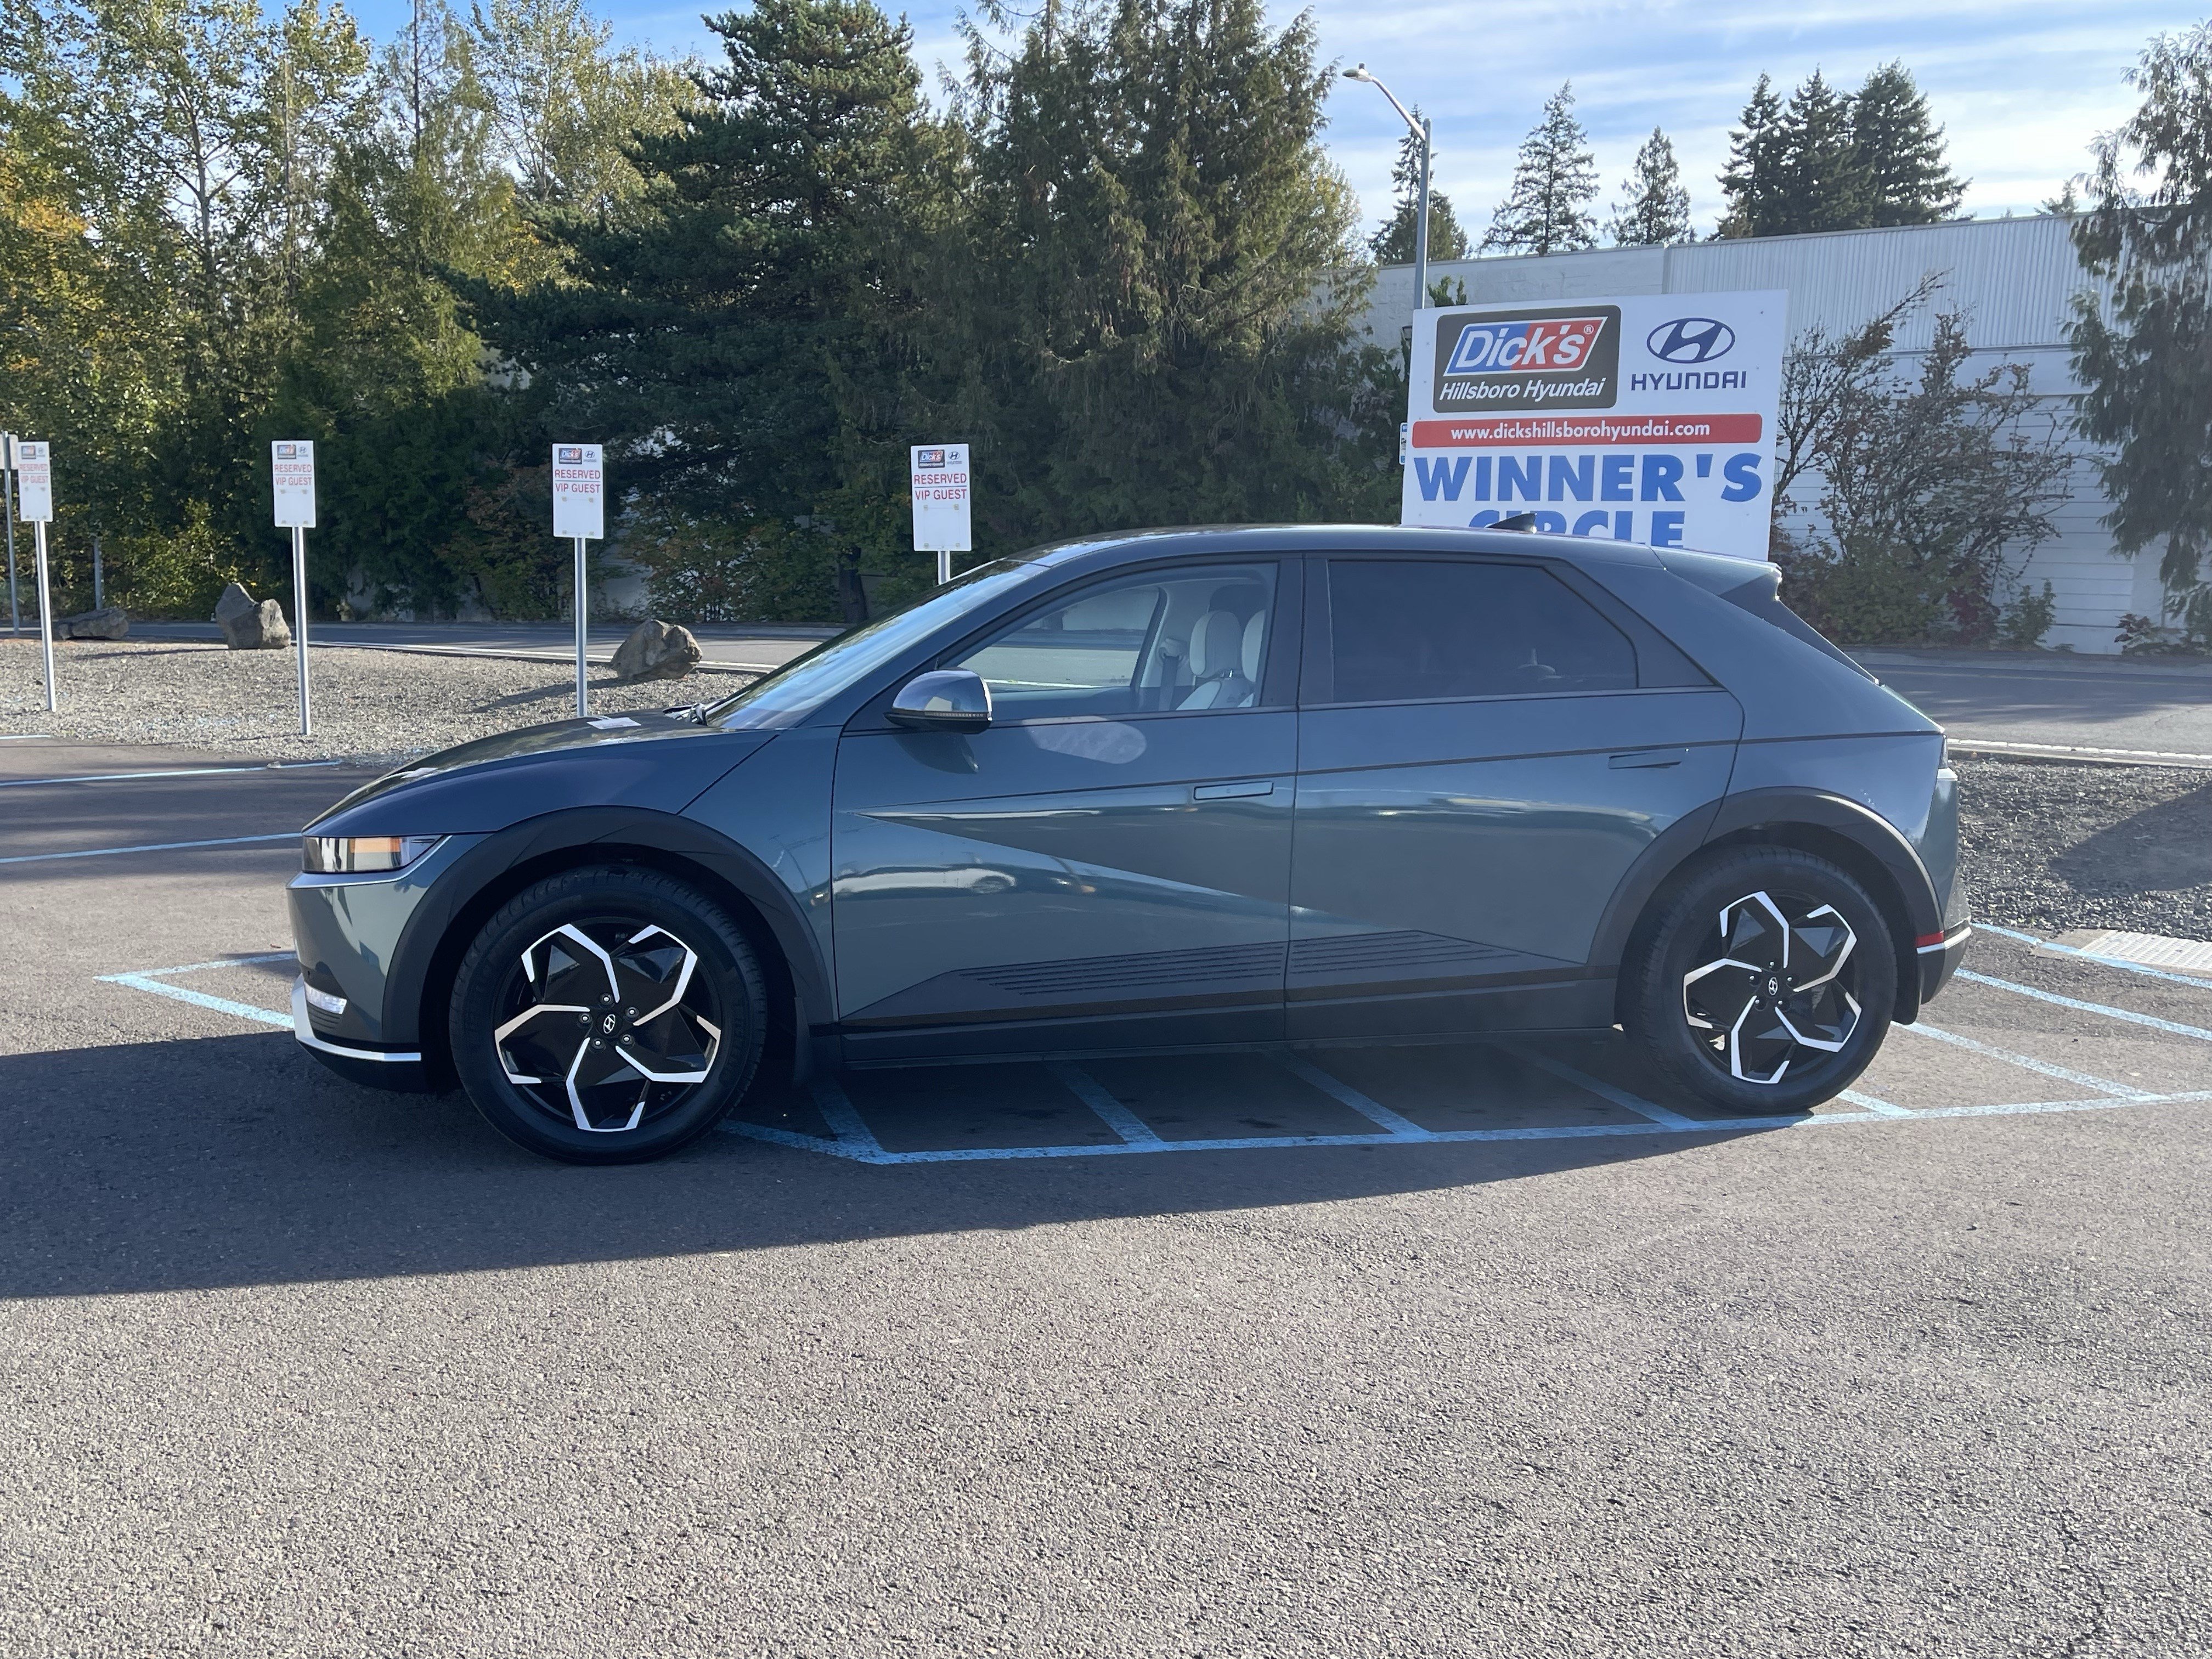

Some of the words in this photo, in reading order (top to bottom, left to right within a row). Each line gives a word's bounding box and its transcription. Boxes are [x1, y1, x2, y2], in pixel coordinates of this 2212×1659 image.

[1631, 371, 1747, 391] HYUNDAI
[1439, 381, 1520, 400] Hillsboro
[1523, 377, 1606, 402] Hyundai
[1451, 419, 1711, 441] www.dickshillsborohyundai.com
[274, 464, 312, 472] RESERVED
[555, 469, 601, 479] RESERVED
[914, 473, 967, 484] RESERVED
[1413, 452, 1763, 502] WINNER'S
[275, 477, 286, 486] VIP
[288, 477, 312, 486] GUEST
[555, 483, 569, 492] VIP
[572, 483, 601, 493] GUEST
[915, 490, 930, 500] VIP
[933, 489, 967, 500] GUEST
[1469, 510, 1685, 549] CLE
